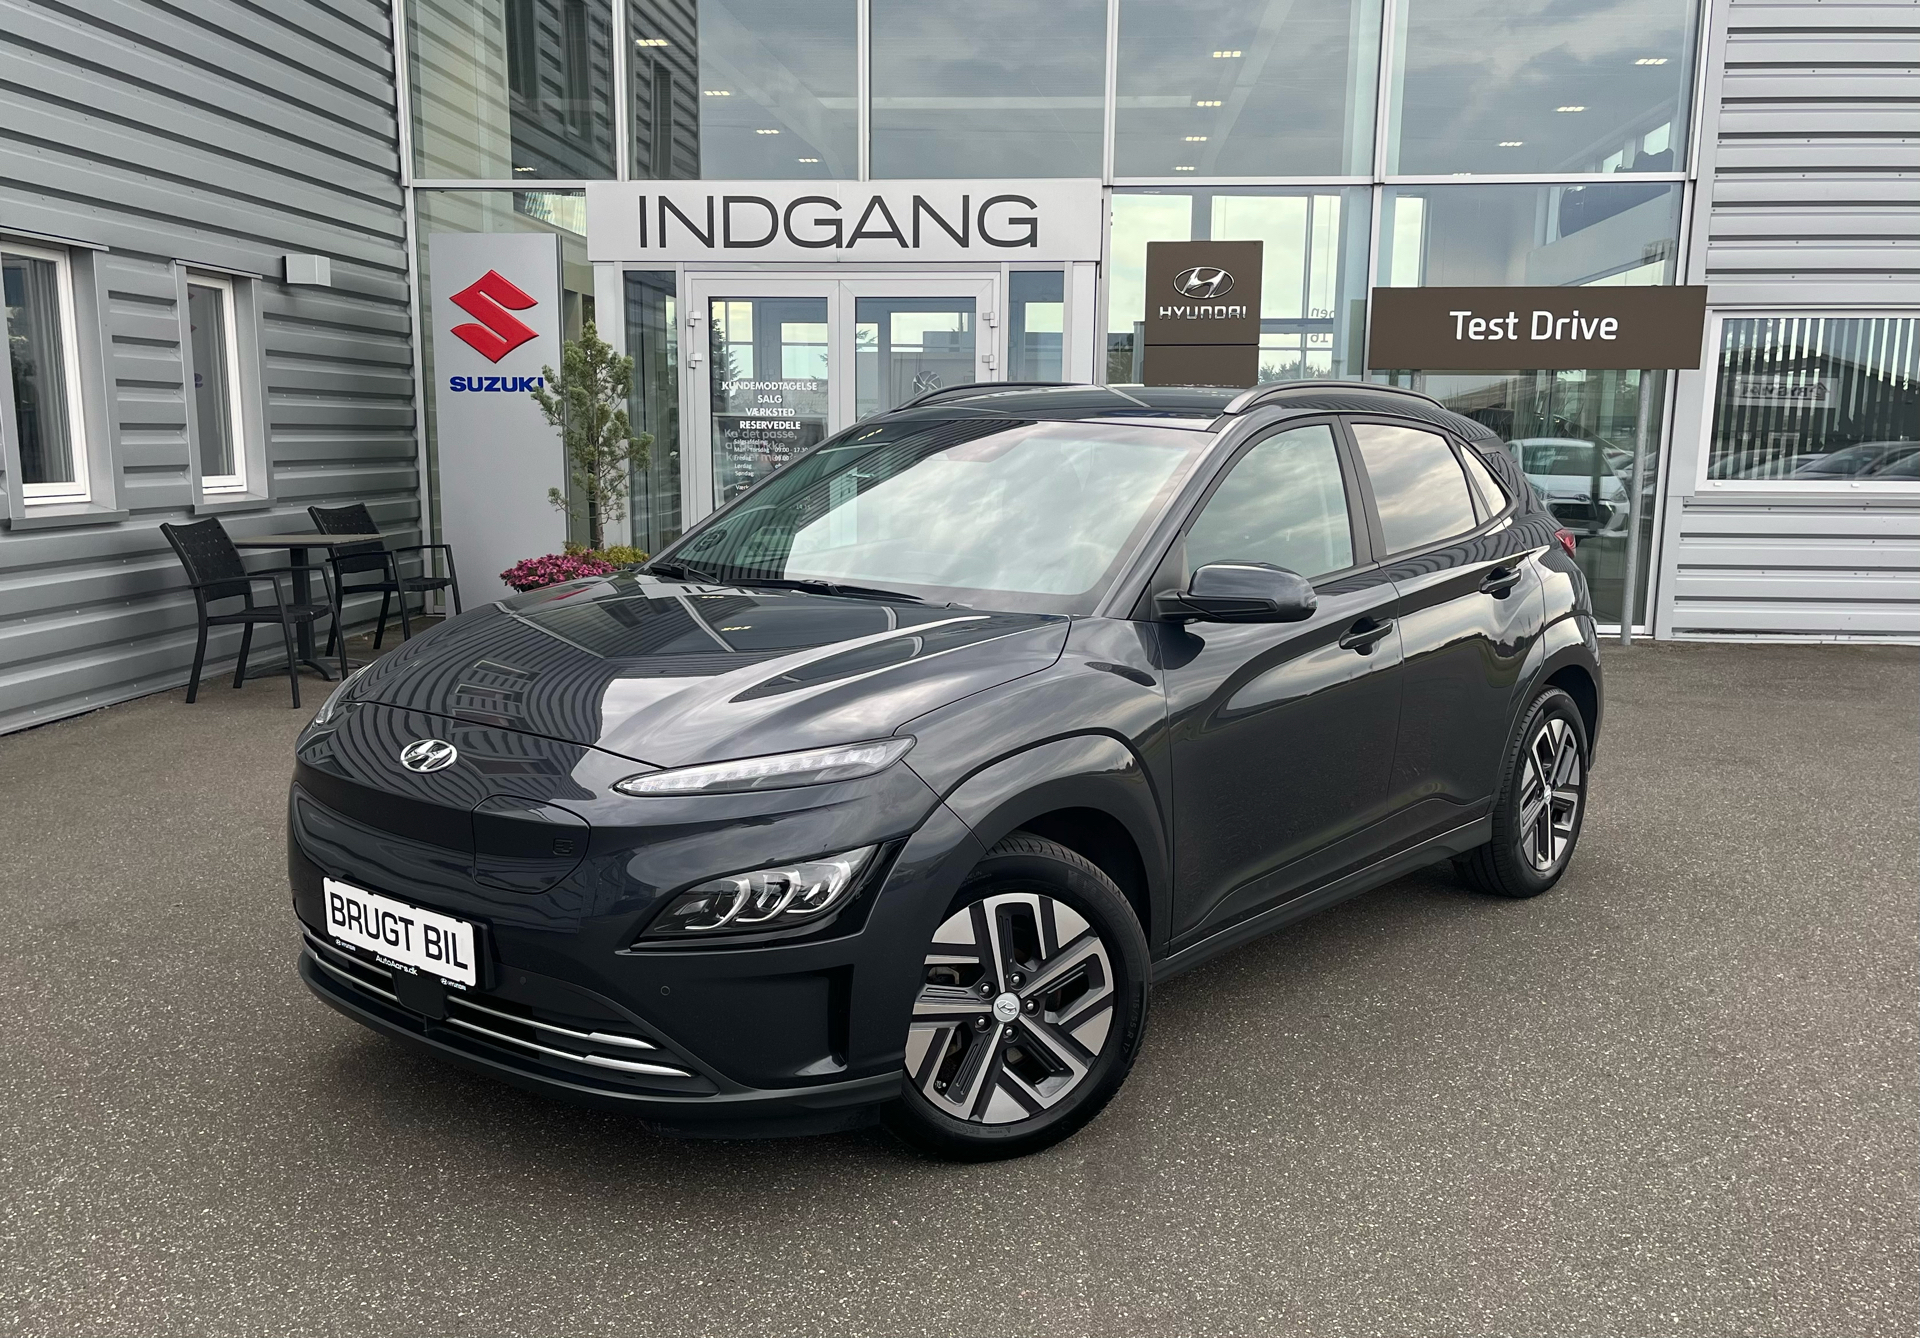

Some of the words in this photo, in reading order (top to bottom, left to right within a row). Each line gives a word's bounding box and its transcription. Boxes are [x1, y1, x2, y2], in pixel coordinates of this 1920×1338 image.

[639, 194, 1038, 249] INDGANG
[1159, 305, 1247, 319] HYUNDAI
[1449, 310, 1519, 340] Test
[1530, 309, 1618, 340] Drive
[449, 376, 544, 392] SUZUKI
[721, 381, 818, 391] KUNDEMODTAGELSE
[757, 394, 783, 404] SALG
[745, 407, 796, 417] VÆRKSTED
[739, 420, 801, 430] RESERVEDELE
[742, 429, 760, 439] det
[762, 430, 798, 440] passe,
[329, 891, 415, 952] BRUGT
[423, 923, 469, 971] BIL
